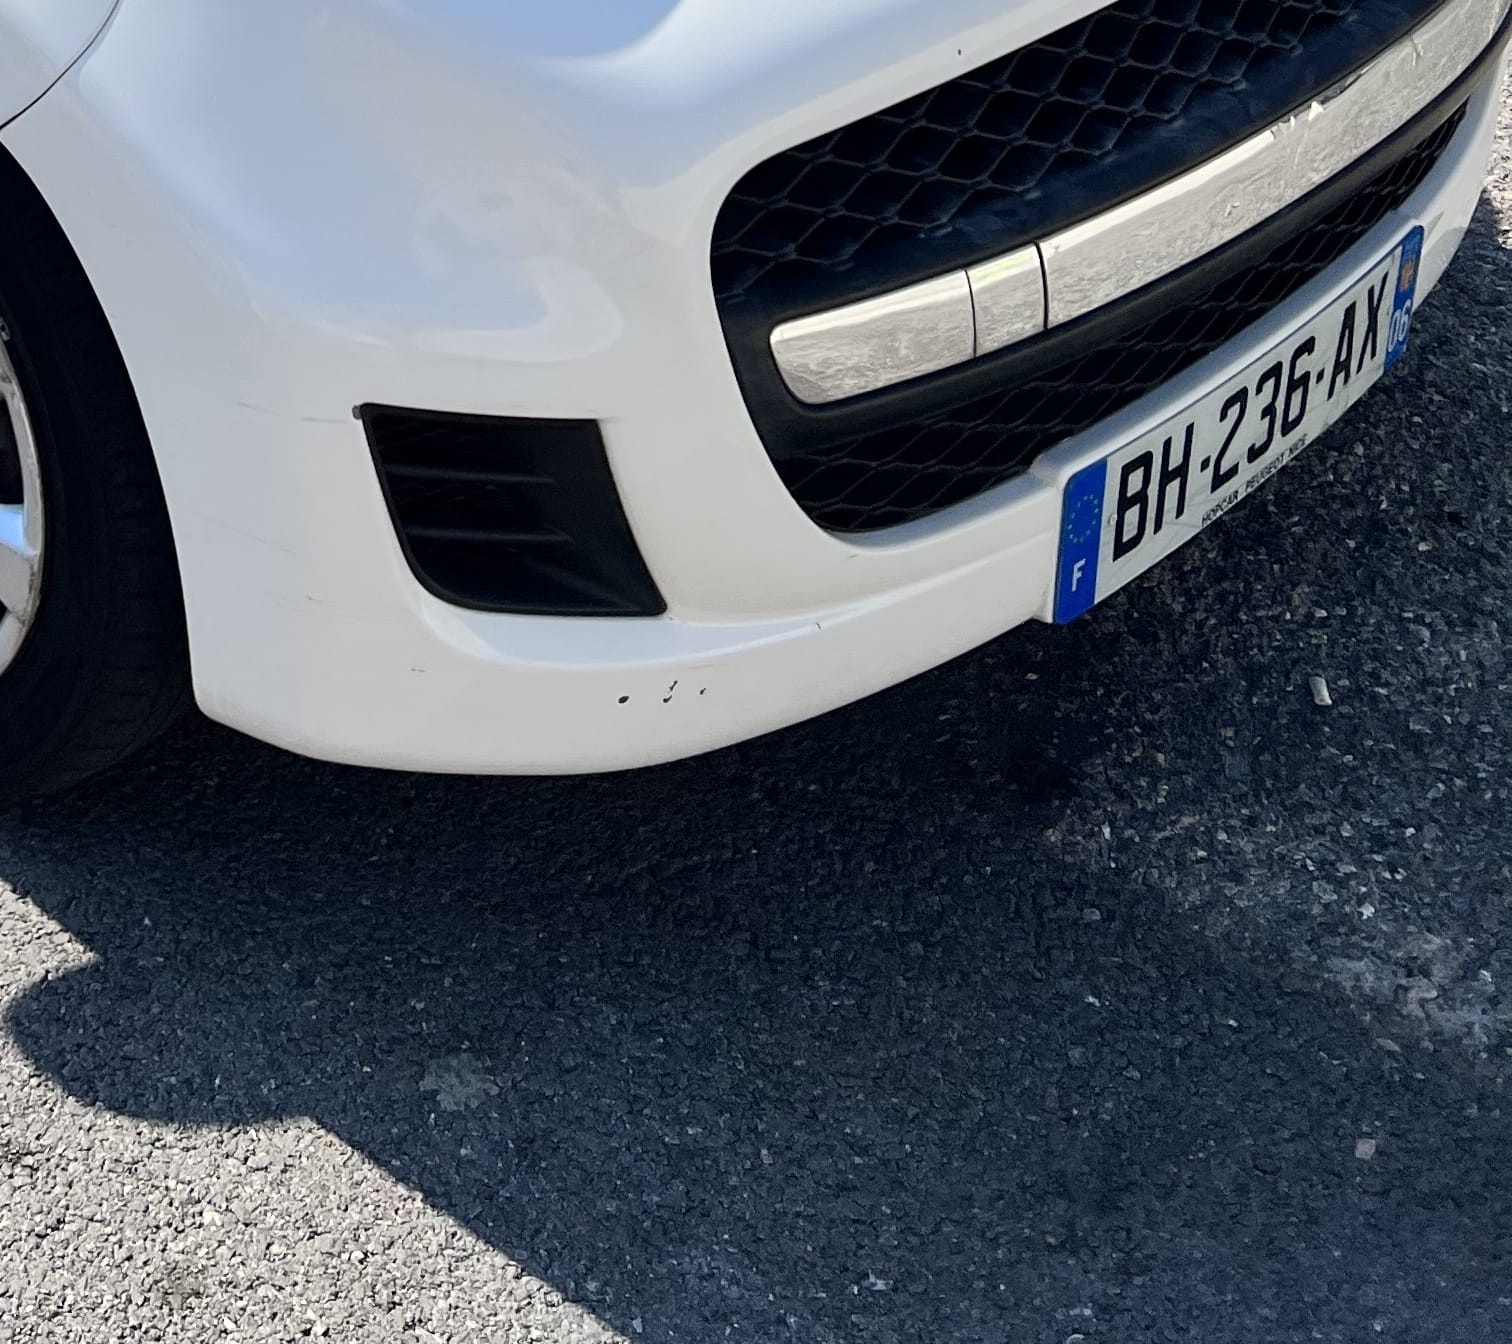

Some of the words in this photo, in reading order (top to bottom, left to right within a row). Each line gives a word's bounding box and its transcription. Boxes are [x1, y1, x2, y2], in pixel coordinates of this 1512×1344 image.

[1387, 298, 1412, 353] 06
[1111, 270, 1389, 563] BH-236-AX
[1070, 557, 1086, 592] F
